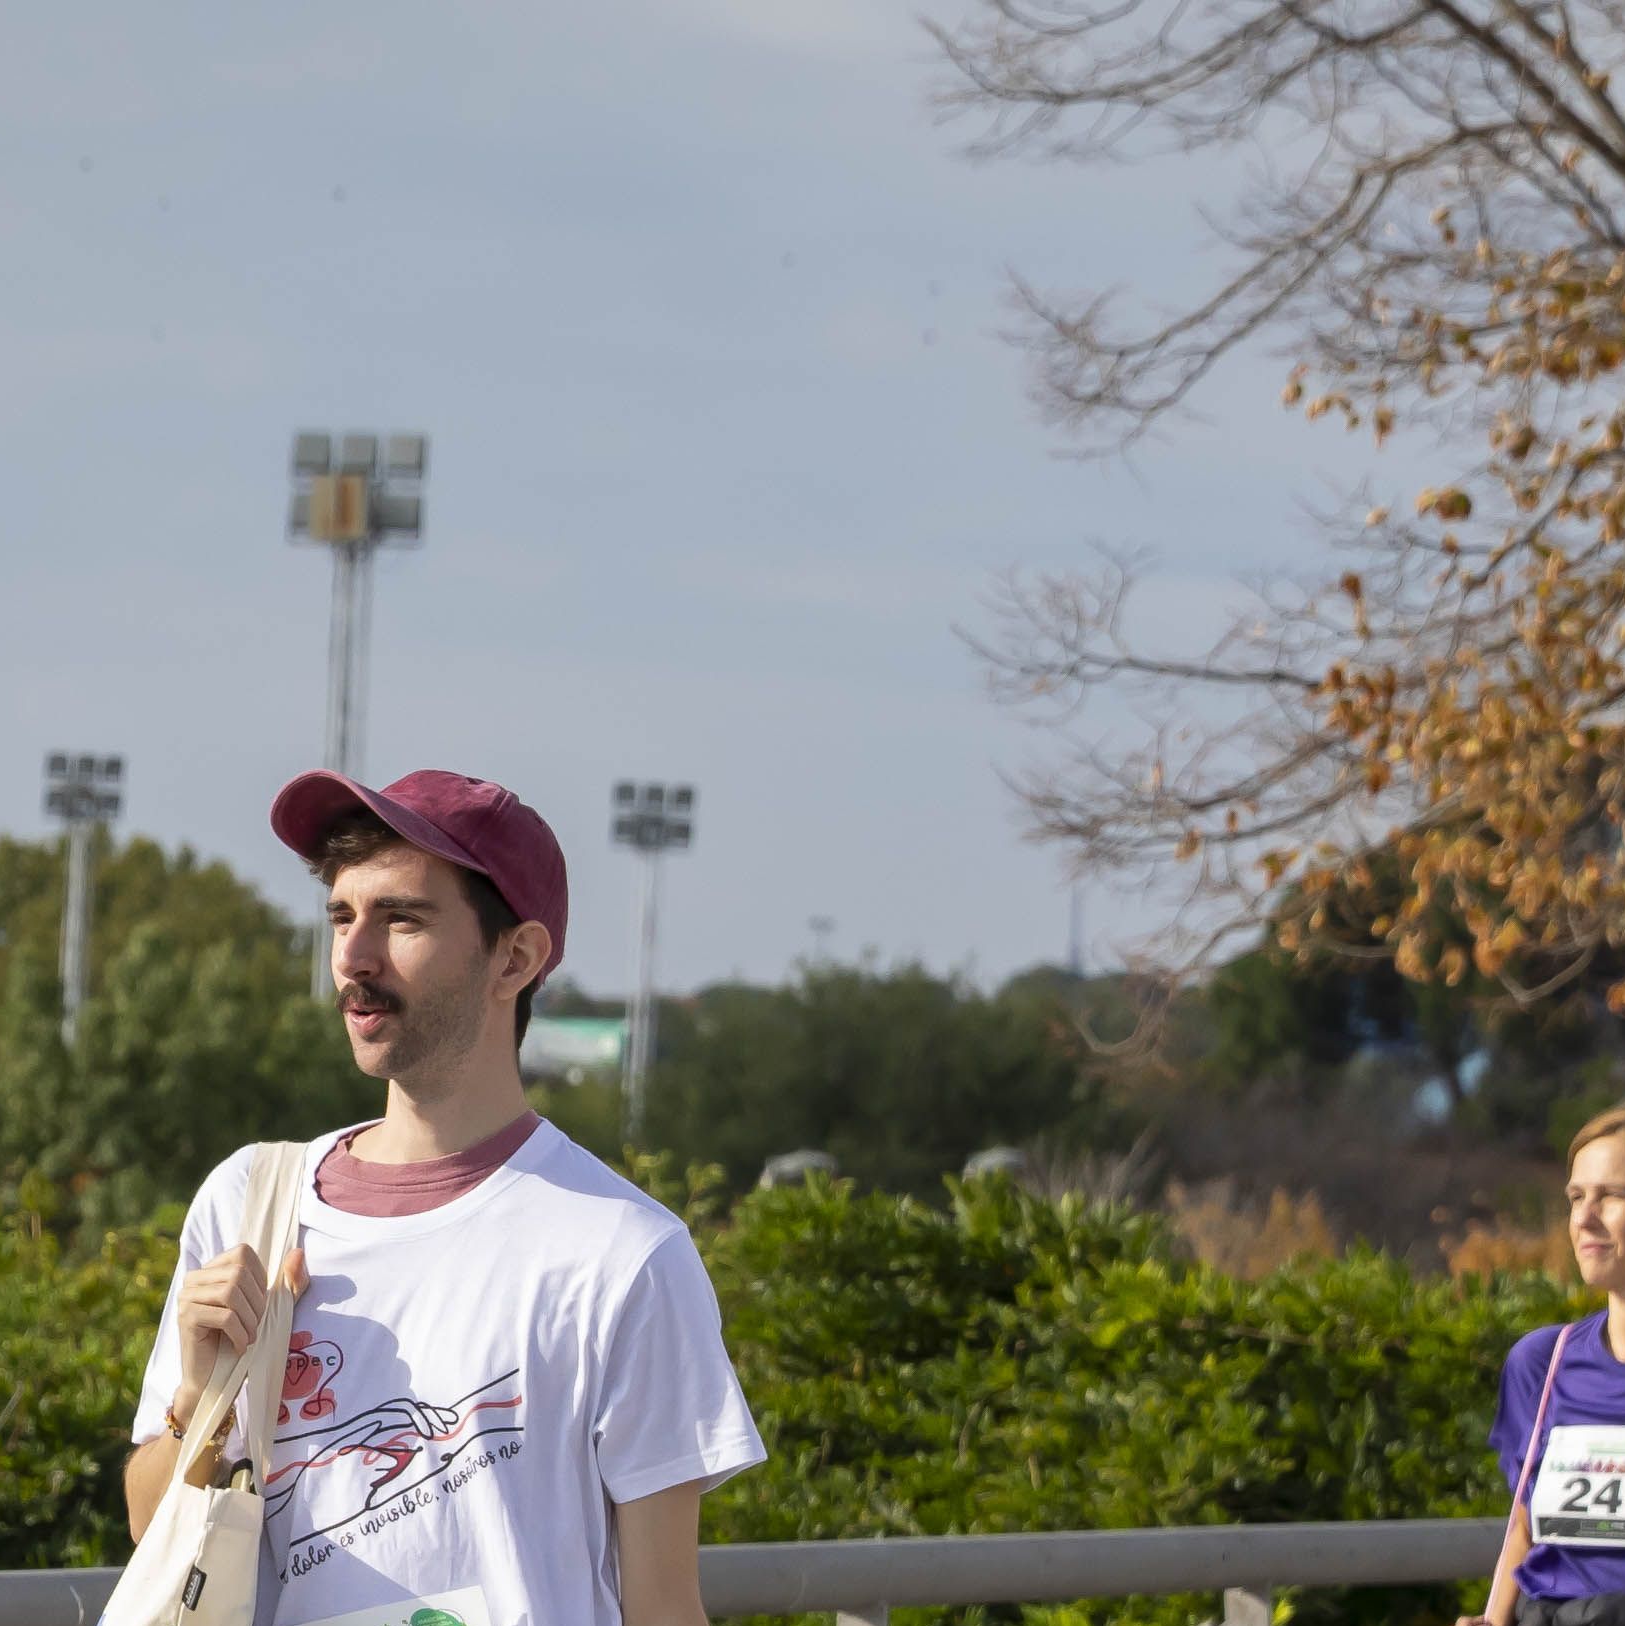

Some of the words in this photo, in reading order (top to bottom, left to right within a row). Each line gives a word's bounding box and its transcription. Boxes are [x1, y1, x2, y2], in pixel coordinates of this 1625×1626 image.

[291, 1543, 335, 1576] dolor
[340, 1532, 356, 1548] es
[442, 1450, 496, 1494] nosotros
[499, 1441, 523, 1460] no
